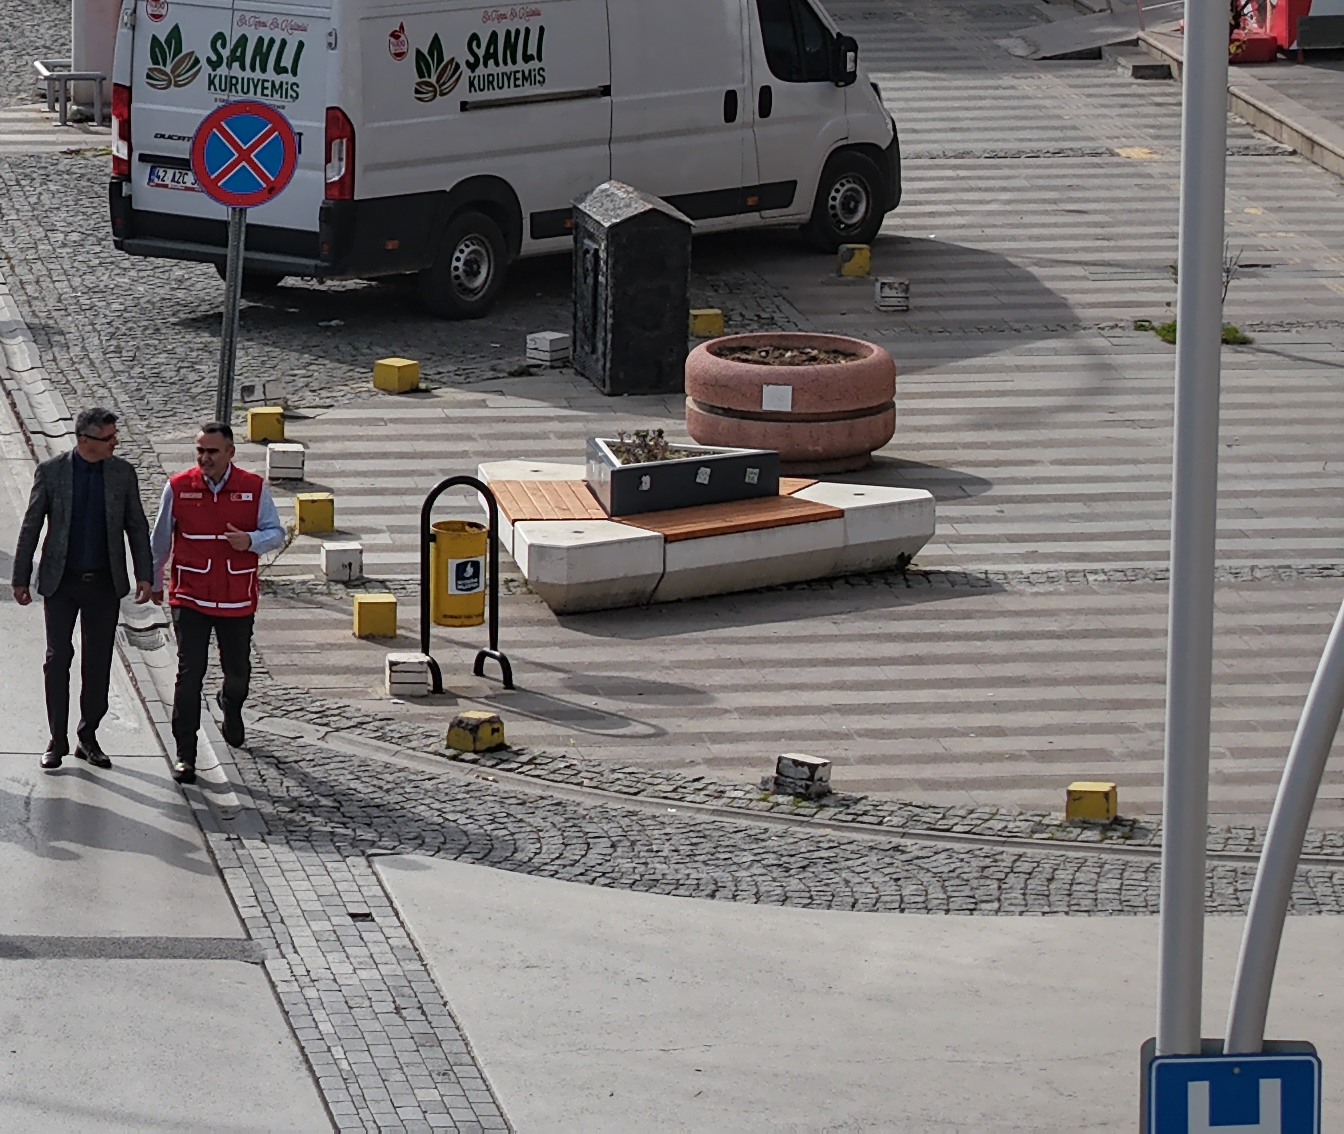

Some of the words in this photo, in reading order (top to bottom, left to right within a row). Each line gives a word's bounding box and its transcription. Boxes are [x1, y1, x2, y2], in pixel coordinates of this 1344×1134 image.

[205, 31, 305, 78] ŞANLI
[464, 24, 546, 73] ŞANLI
[207, 72, 300, 102] KURUYEMİŞ
[468, 66, 546, 94] KURUYEMİŞ
[154, 132, 193, 142] DUCAT
[155, 168, 169, 183] 42
[170, 170, 190, 186] AZC
[1187, 1078, 1282, 1134] H
